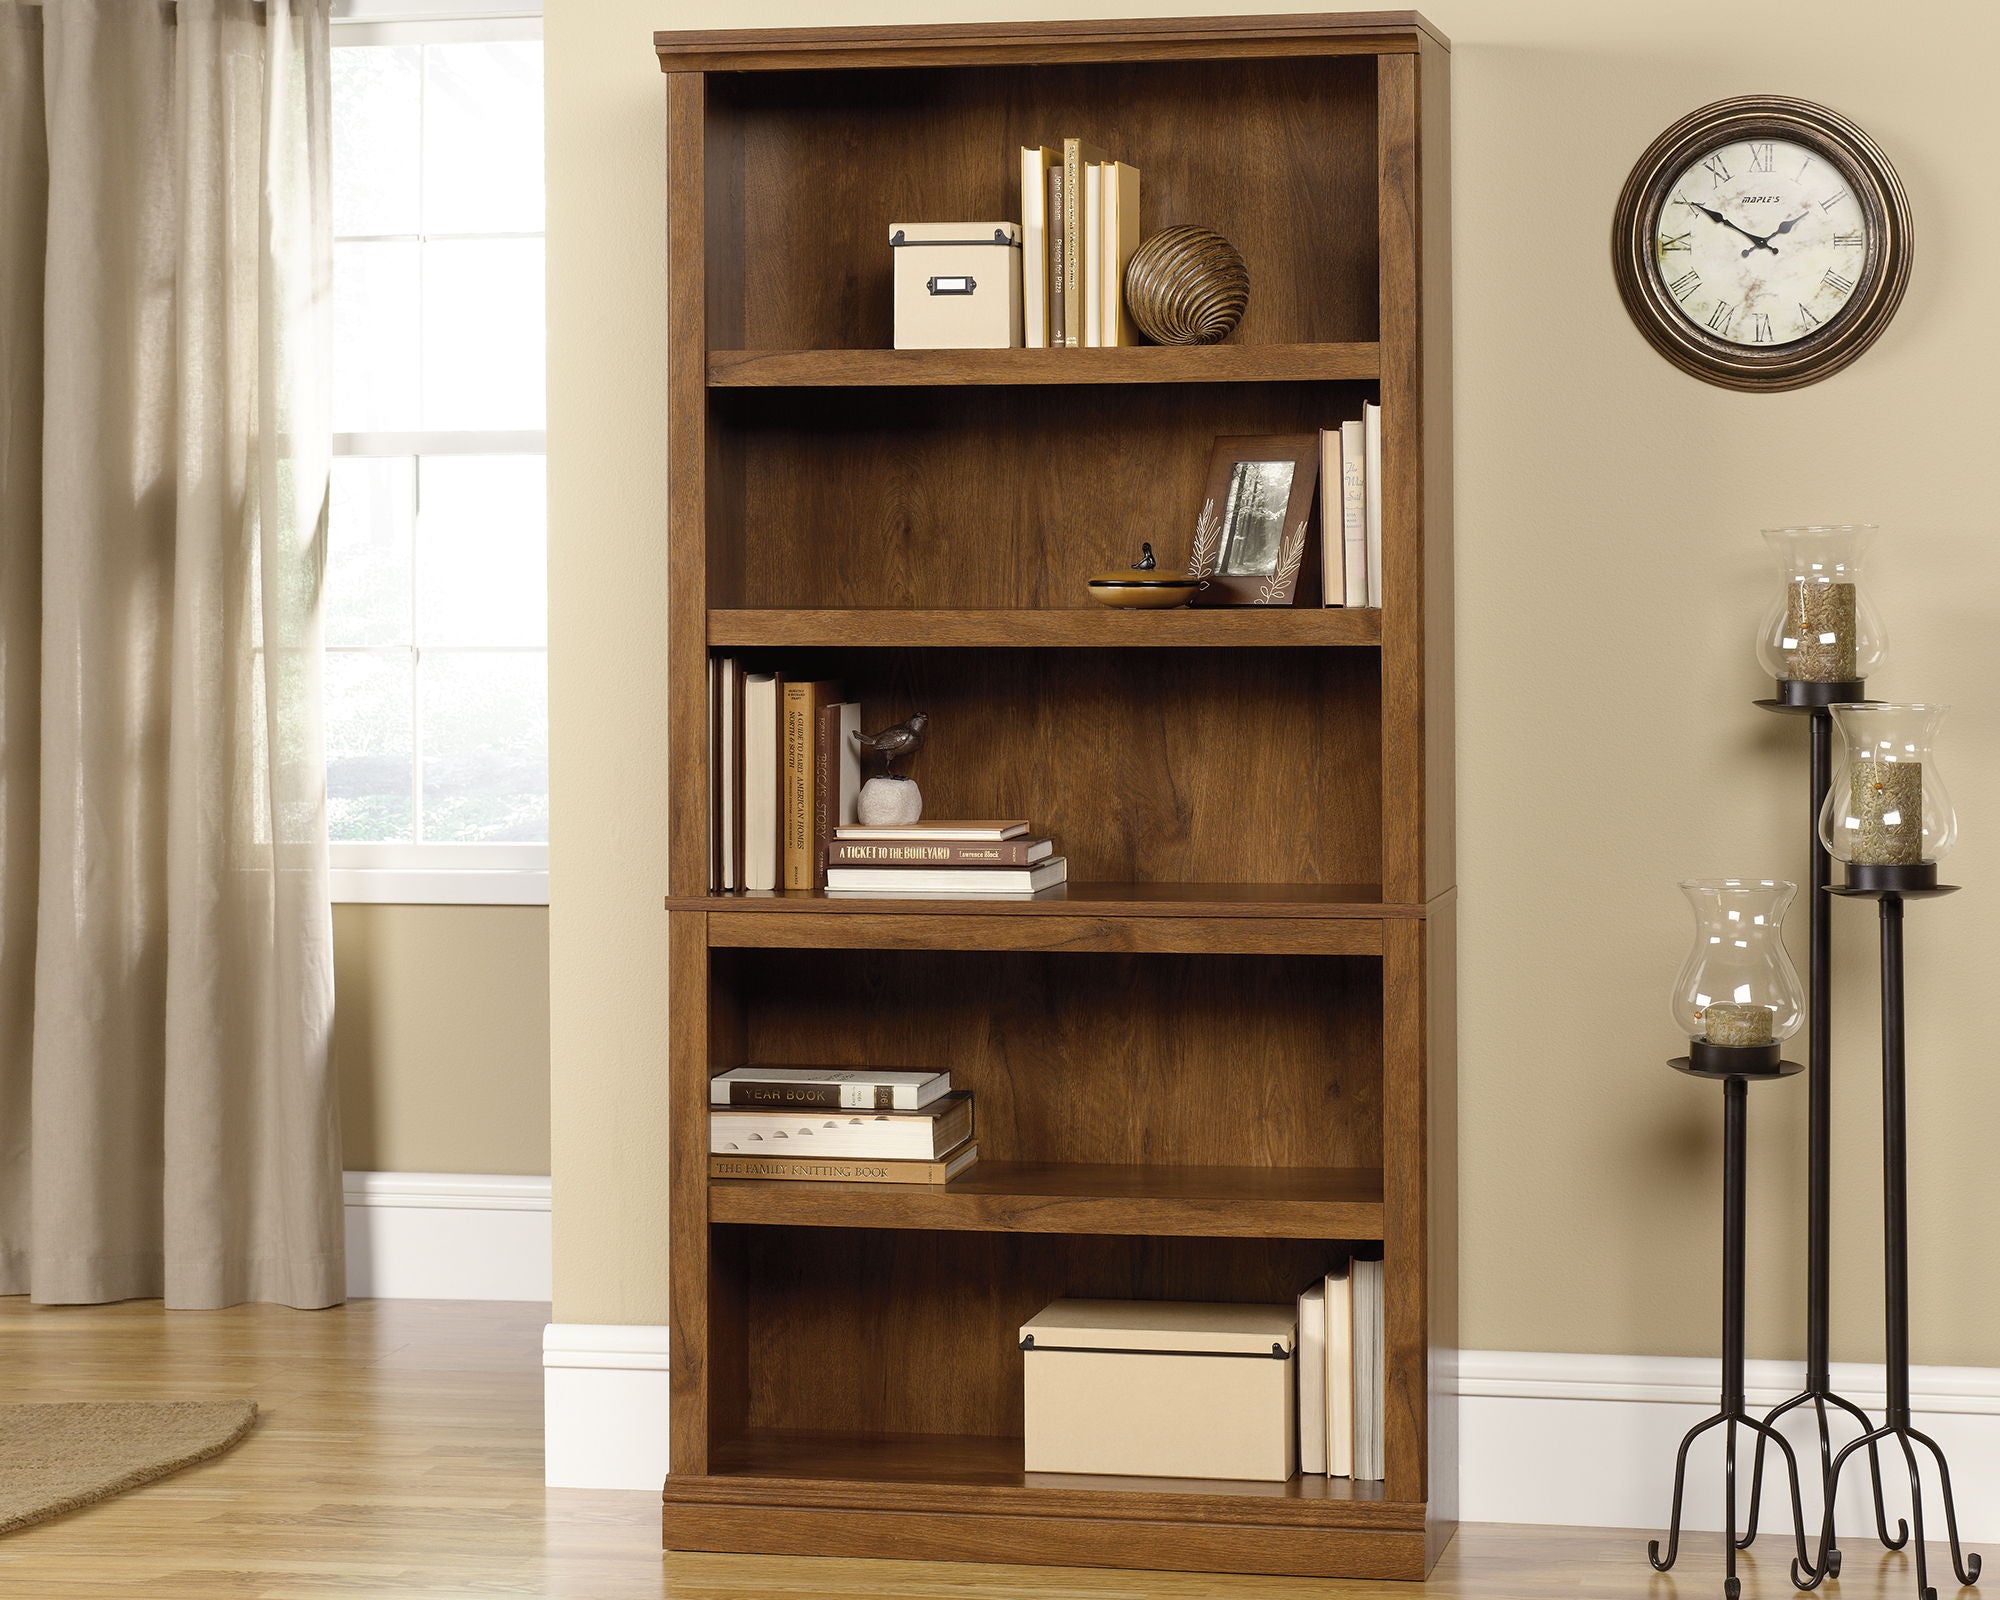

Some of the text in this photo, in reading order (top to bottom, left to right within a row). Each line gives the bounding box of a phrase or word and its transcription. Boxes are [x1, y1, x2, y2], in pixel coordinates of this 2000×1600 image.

[1703, 152, 1735, 190] XI
[1747, 142, 1777, 173] XII
[1054, 174, 1062, 221] John Grisham
[1741, 195, 1781, 204] MAPLE'S
[1662, 232, 1692, 256] IX
[1833, 232, 1864, 249] III
[1054, 238, 1063, 293] Playing for Pizza
[1704, 299, 1736, 337] VII
[1752, 312, 1775, 343] VI
[1799, 302, 1822, 332] V
[797, 742, 804, 752] TO
[796, 776, 804, 819] AMERICAN
[816, 799, 827, 839] STORY
[796, 820, 804, 850] HOMES
[839, 846, 951, 860] A TICKET TO THE BONEYARD
[959, 850, 1000, 858] Lawrence Block
[745, 1088, 826, 1102] YEAR BOOK
[716, 1162, 889, 1178] THE FAMILY KNITTING BOOK
